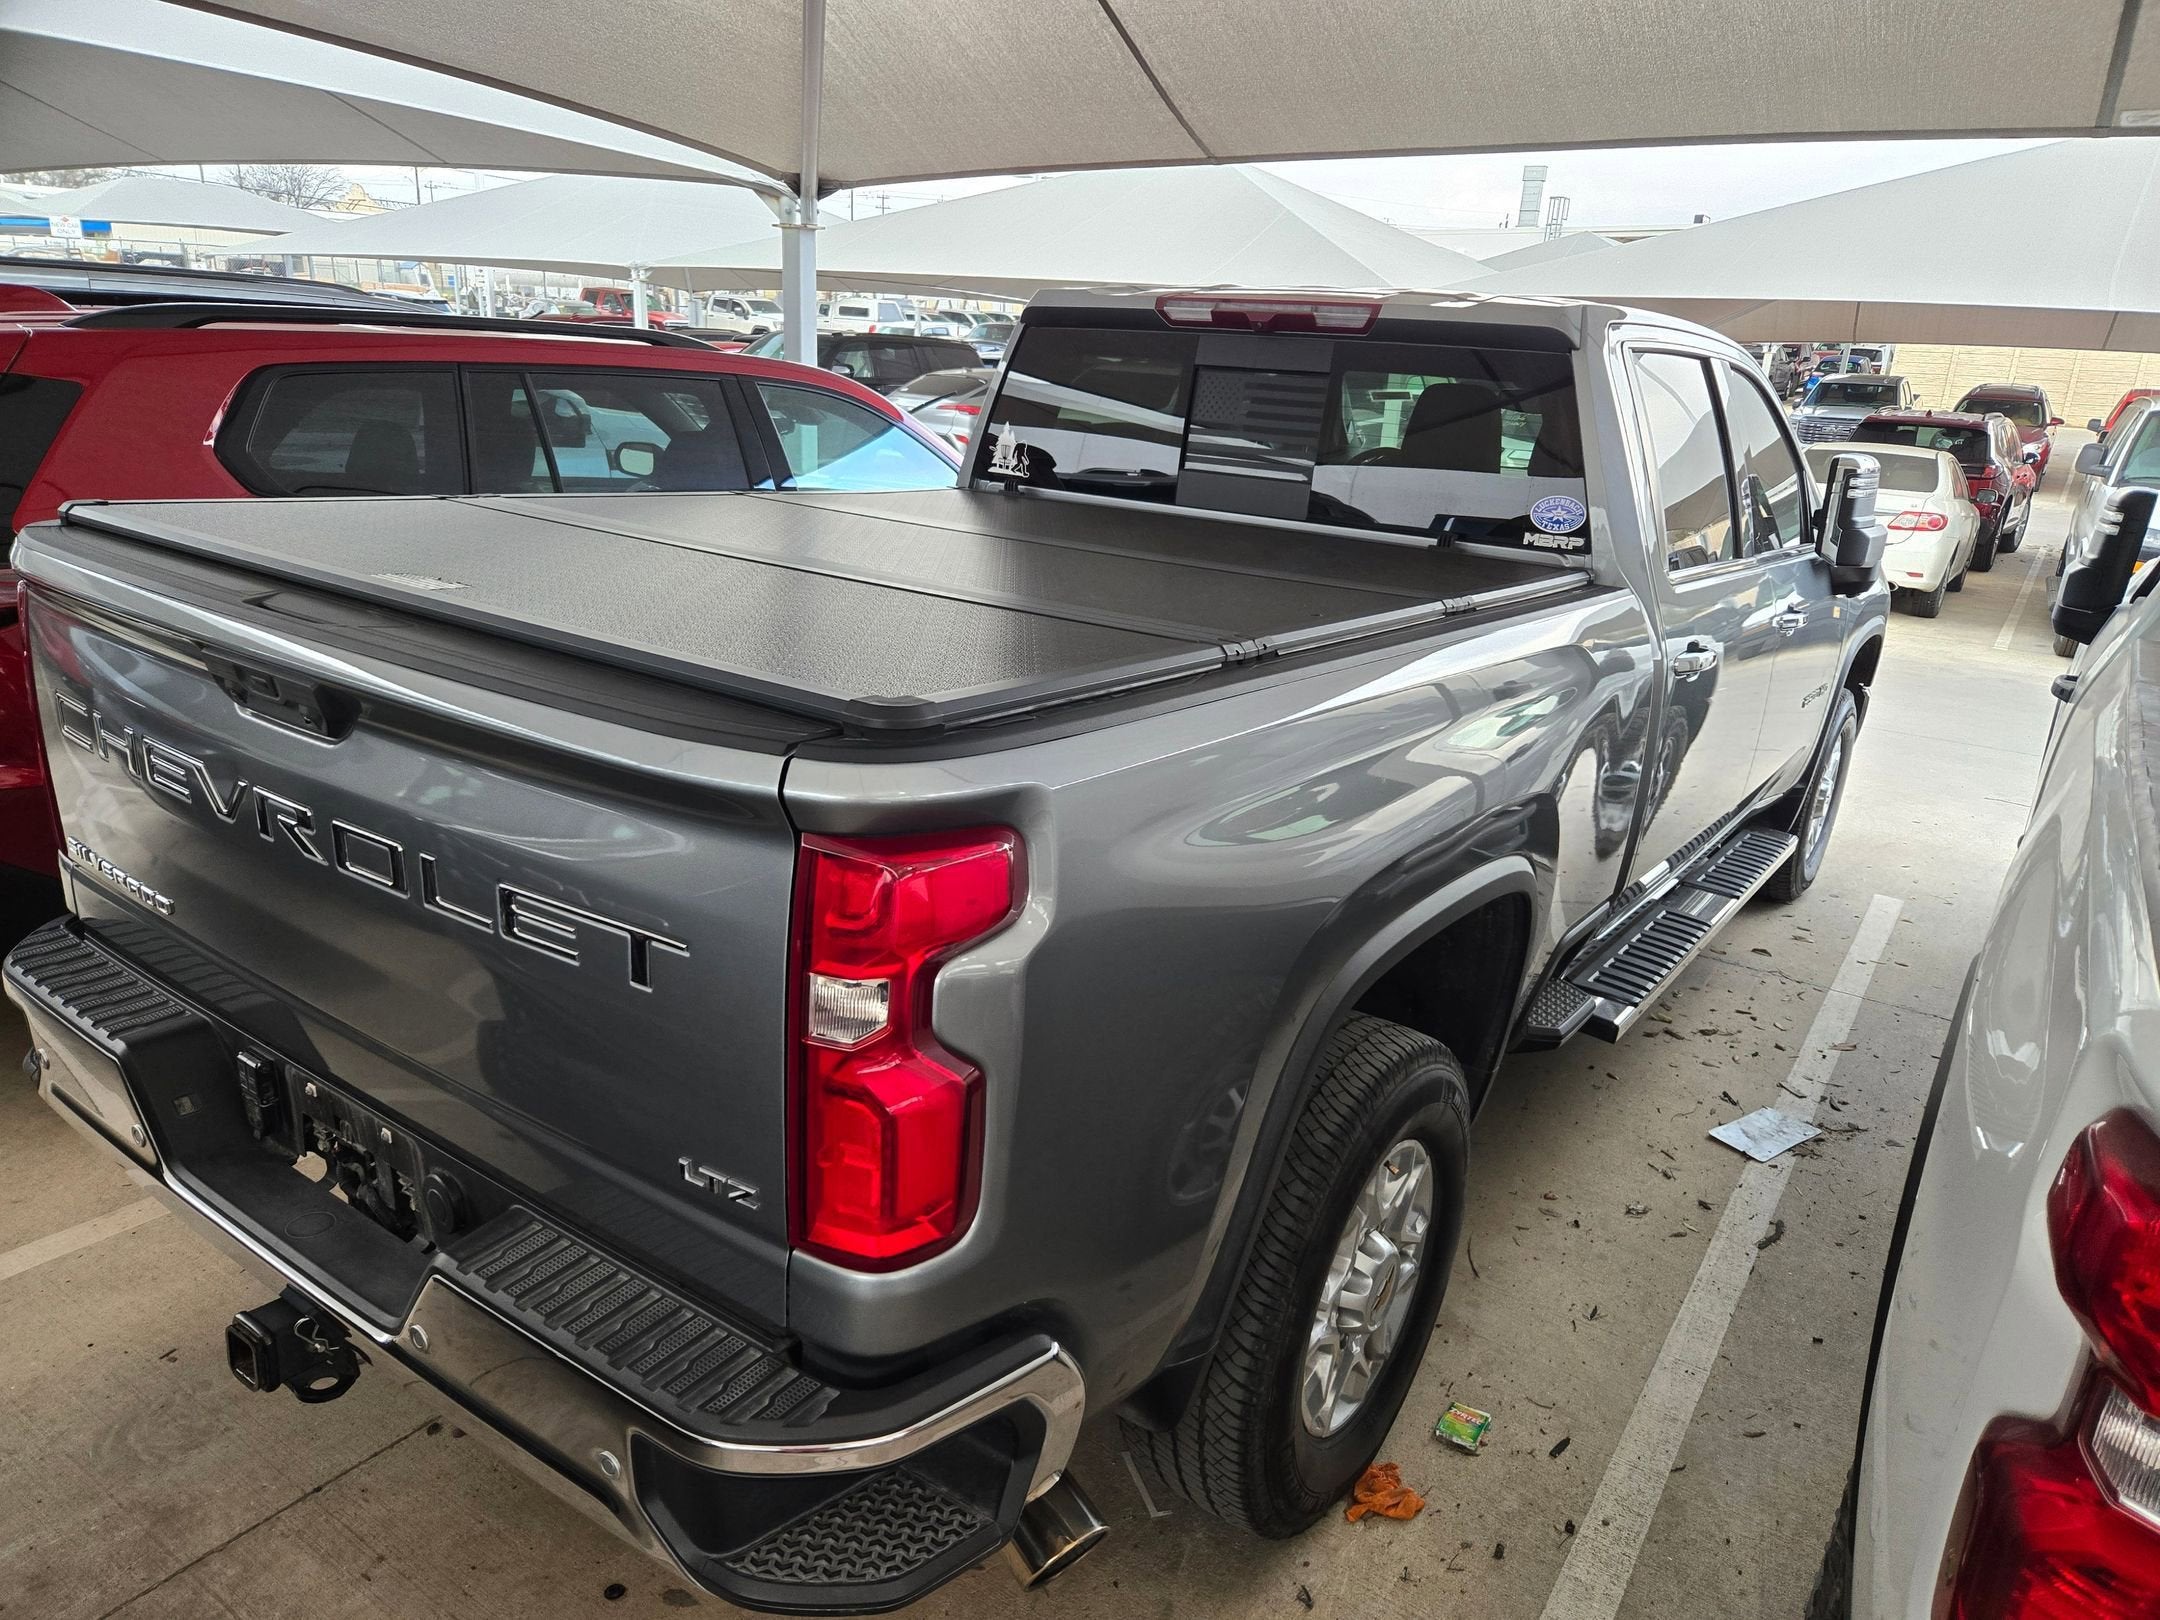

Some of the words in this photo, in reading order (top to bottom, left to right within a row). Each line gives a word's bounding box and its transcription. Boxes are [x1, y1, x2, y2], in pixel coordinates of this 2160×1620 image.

[1534, 498, 1584, 516] LUCKENBACH
[1522, 532, 1585, 550] MBRP
[1541, 520, 1571, 531] TEXAS
[55, 688, 691, 993] CHEVROLET
[67, 835, 176, 916] SILVERADO
[678, 1156, 761, 1211] LTZ
